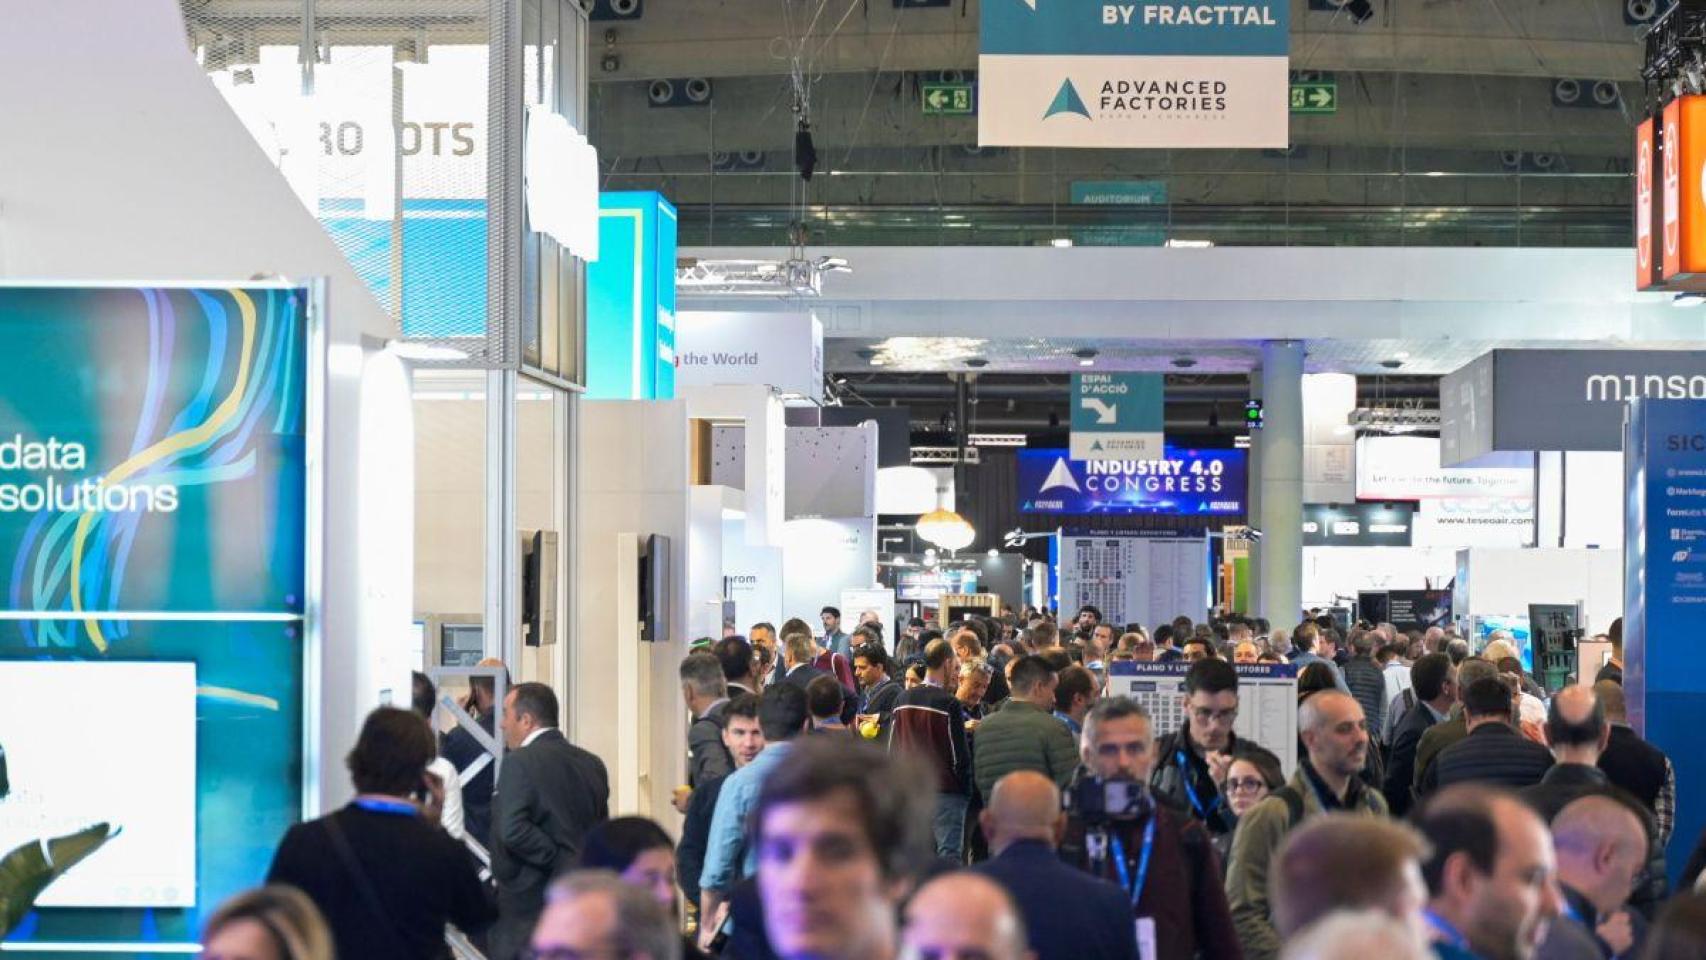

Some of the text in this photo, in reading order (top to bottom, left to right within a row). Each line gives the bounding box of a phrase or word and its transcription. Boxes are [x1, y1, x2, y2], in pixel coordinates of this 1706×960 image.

[1102, 6, 1276, 25] BY FRACTTAL
[1101, 80, 1226, 95] ADVANCED
[1101, 97, 1226, 110] FACTORIES
[684, 352, 708, 365] the
[713, 352, 758, 365] World
[1081, 375, 1111, 383] ESPAI
[0, 433, 86, 470] data
[1086, 459, 1224, 476] INDUSTRY 4.0
[1086, 476, 1222, 492] CONGRESS
[0, 475, 179, 512] solutions
[1136, 663, 1165, 673] PLANO
[1168, 664, 1175, 672] Y
